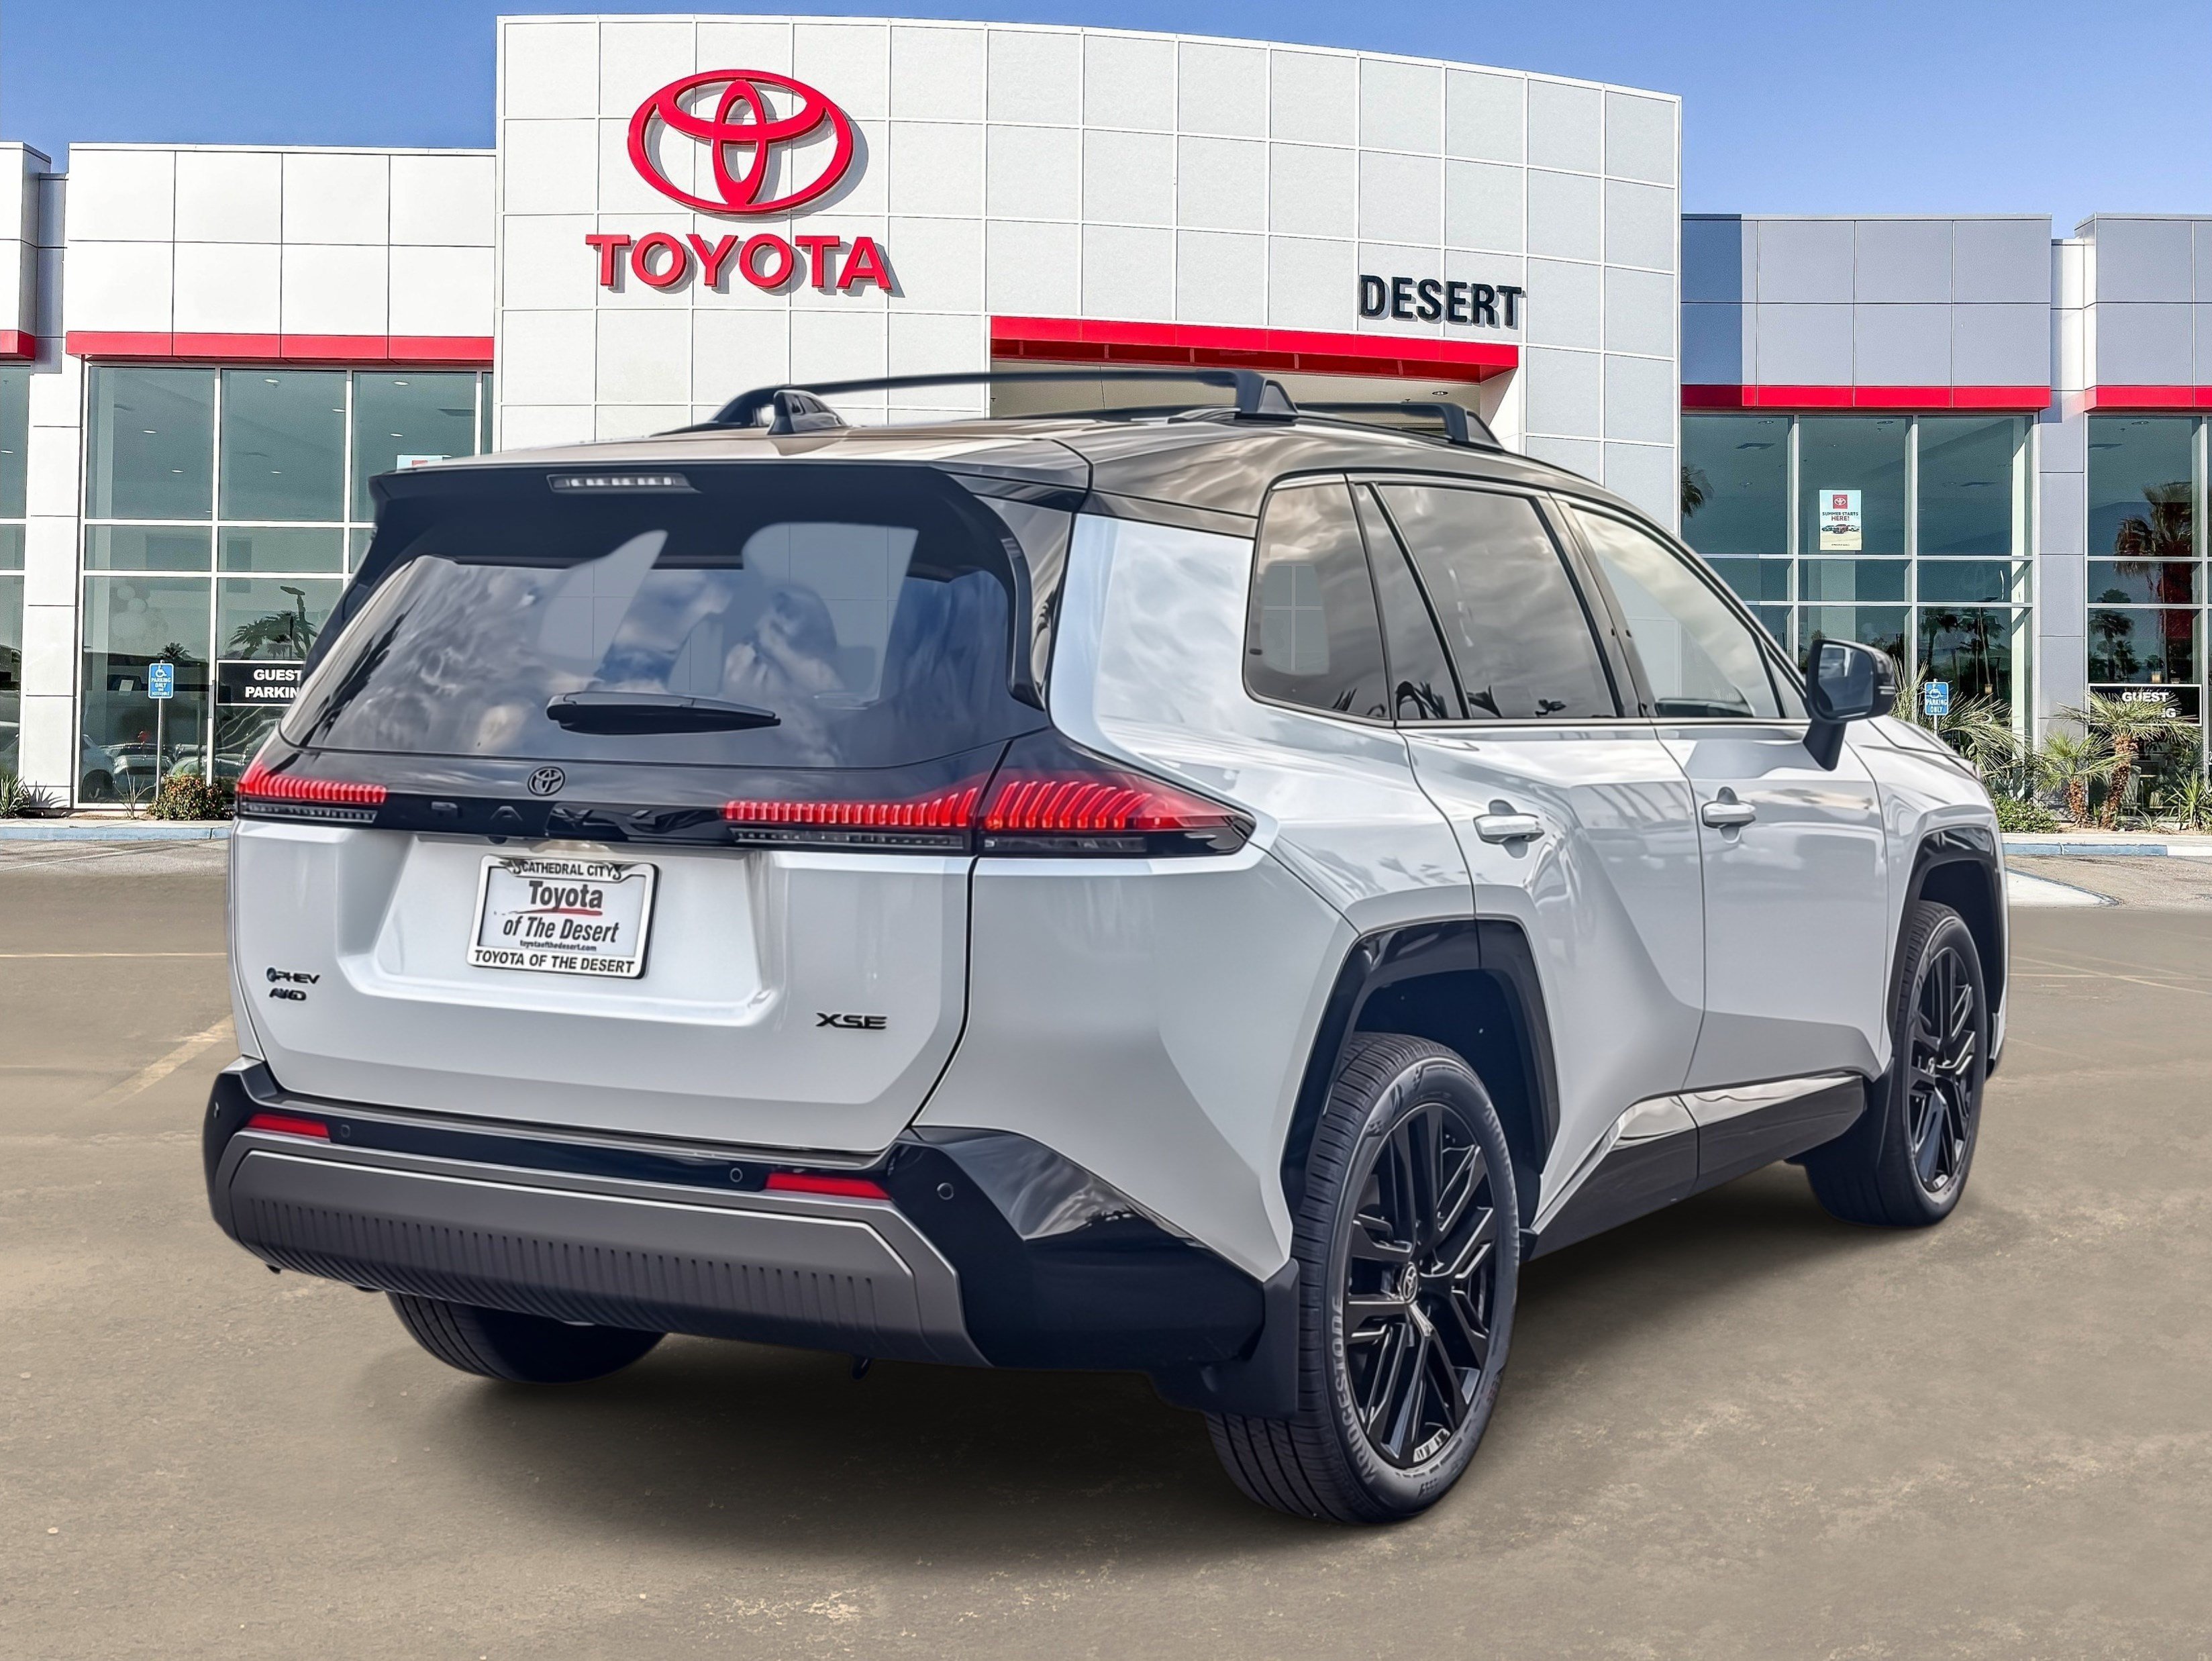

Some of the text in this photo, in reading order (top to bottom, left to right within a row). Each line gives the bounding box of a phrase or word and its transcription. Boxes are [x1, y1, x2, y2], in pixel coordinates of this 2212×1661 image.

[585, 232, 893, 290] TOYOTA
[1359, 274, 1522, 327] DESERT
[253, 668, 303, 681] GUEST
[522, 861, 614, 877] CATHEDRAL CITY
[529, 880, 603, 910] Toyota
[503, 916, 619, 943] of The Desert
[519, 940, 597, 952] toyotaofthedesert.com
[474, 950, 635, 974] TOYOTA OF THE DESERT
[275, 970, 320, 985] PHEV
[815, 1012, 887, 1030] XSE
